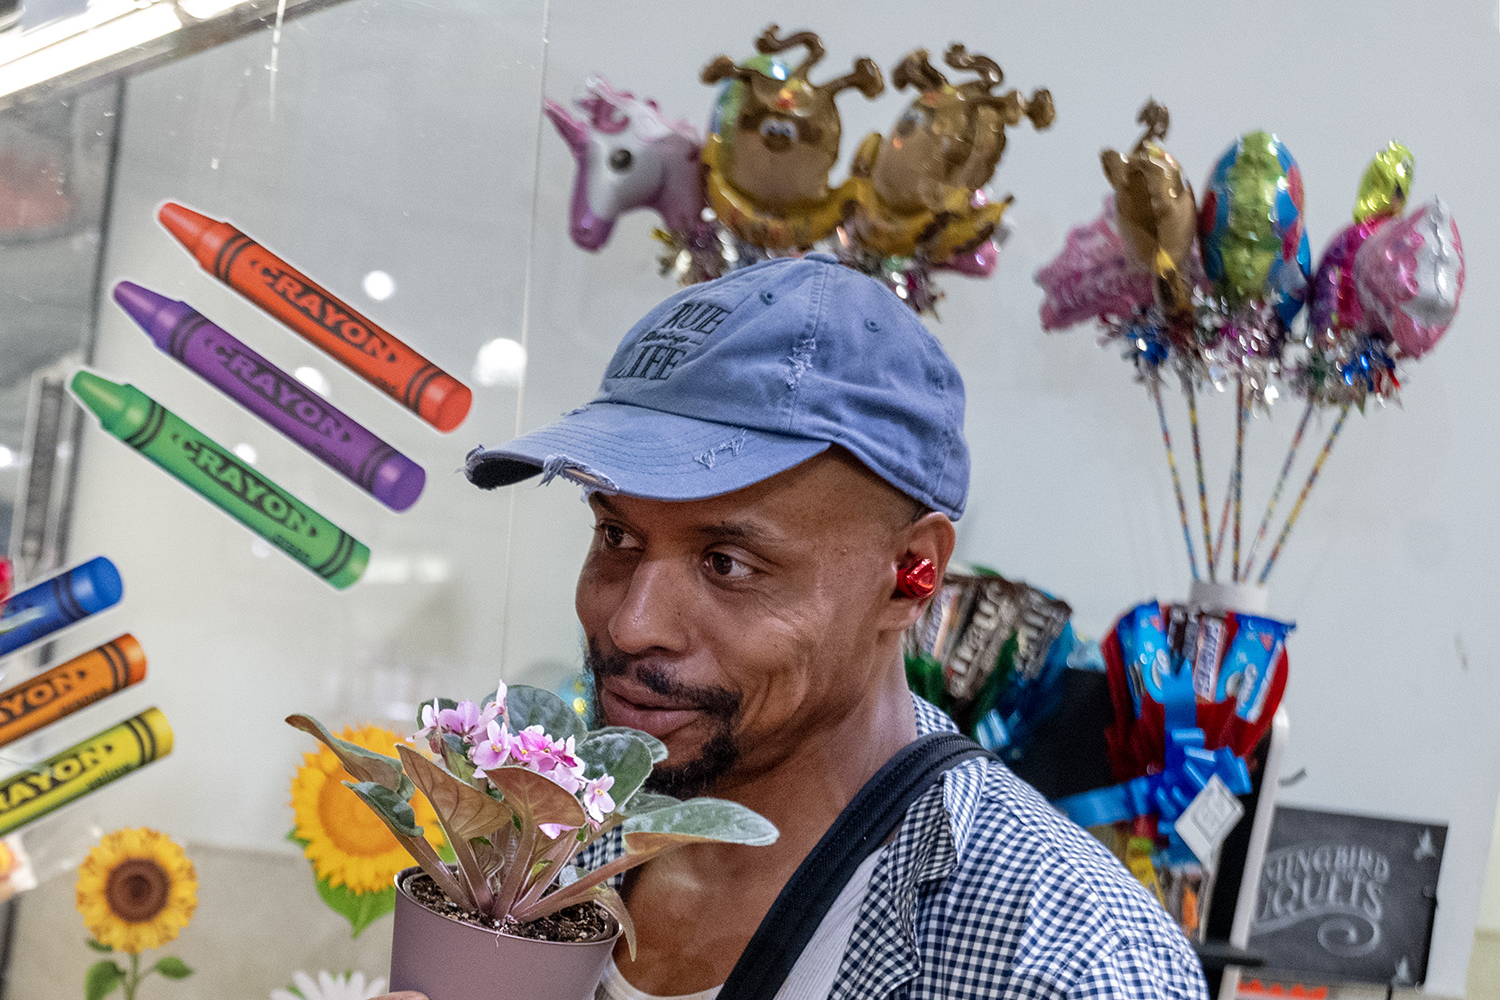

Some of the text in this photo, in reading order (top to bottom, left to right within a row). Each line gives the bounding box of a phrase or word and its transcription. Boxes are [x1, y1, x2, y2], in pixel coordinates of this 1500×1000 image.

[257, 261, 390, 361] CRAYON
[659, 302, 732, 334] RUE
[208, 343, 342, 441] CRAYON
[607, 346, 687, 380] LIFE
[178, 438, 309, 534] CRAYON
